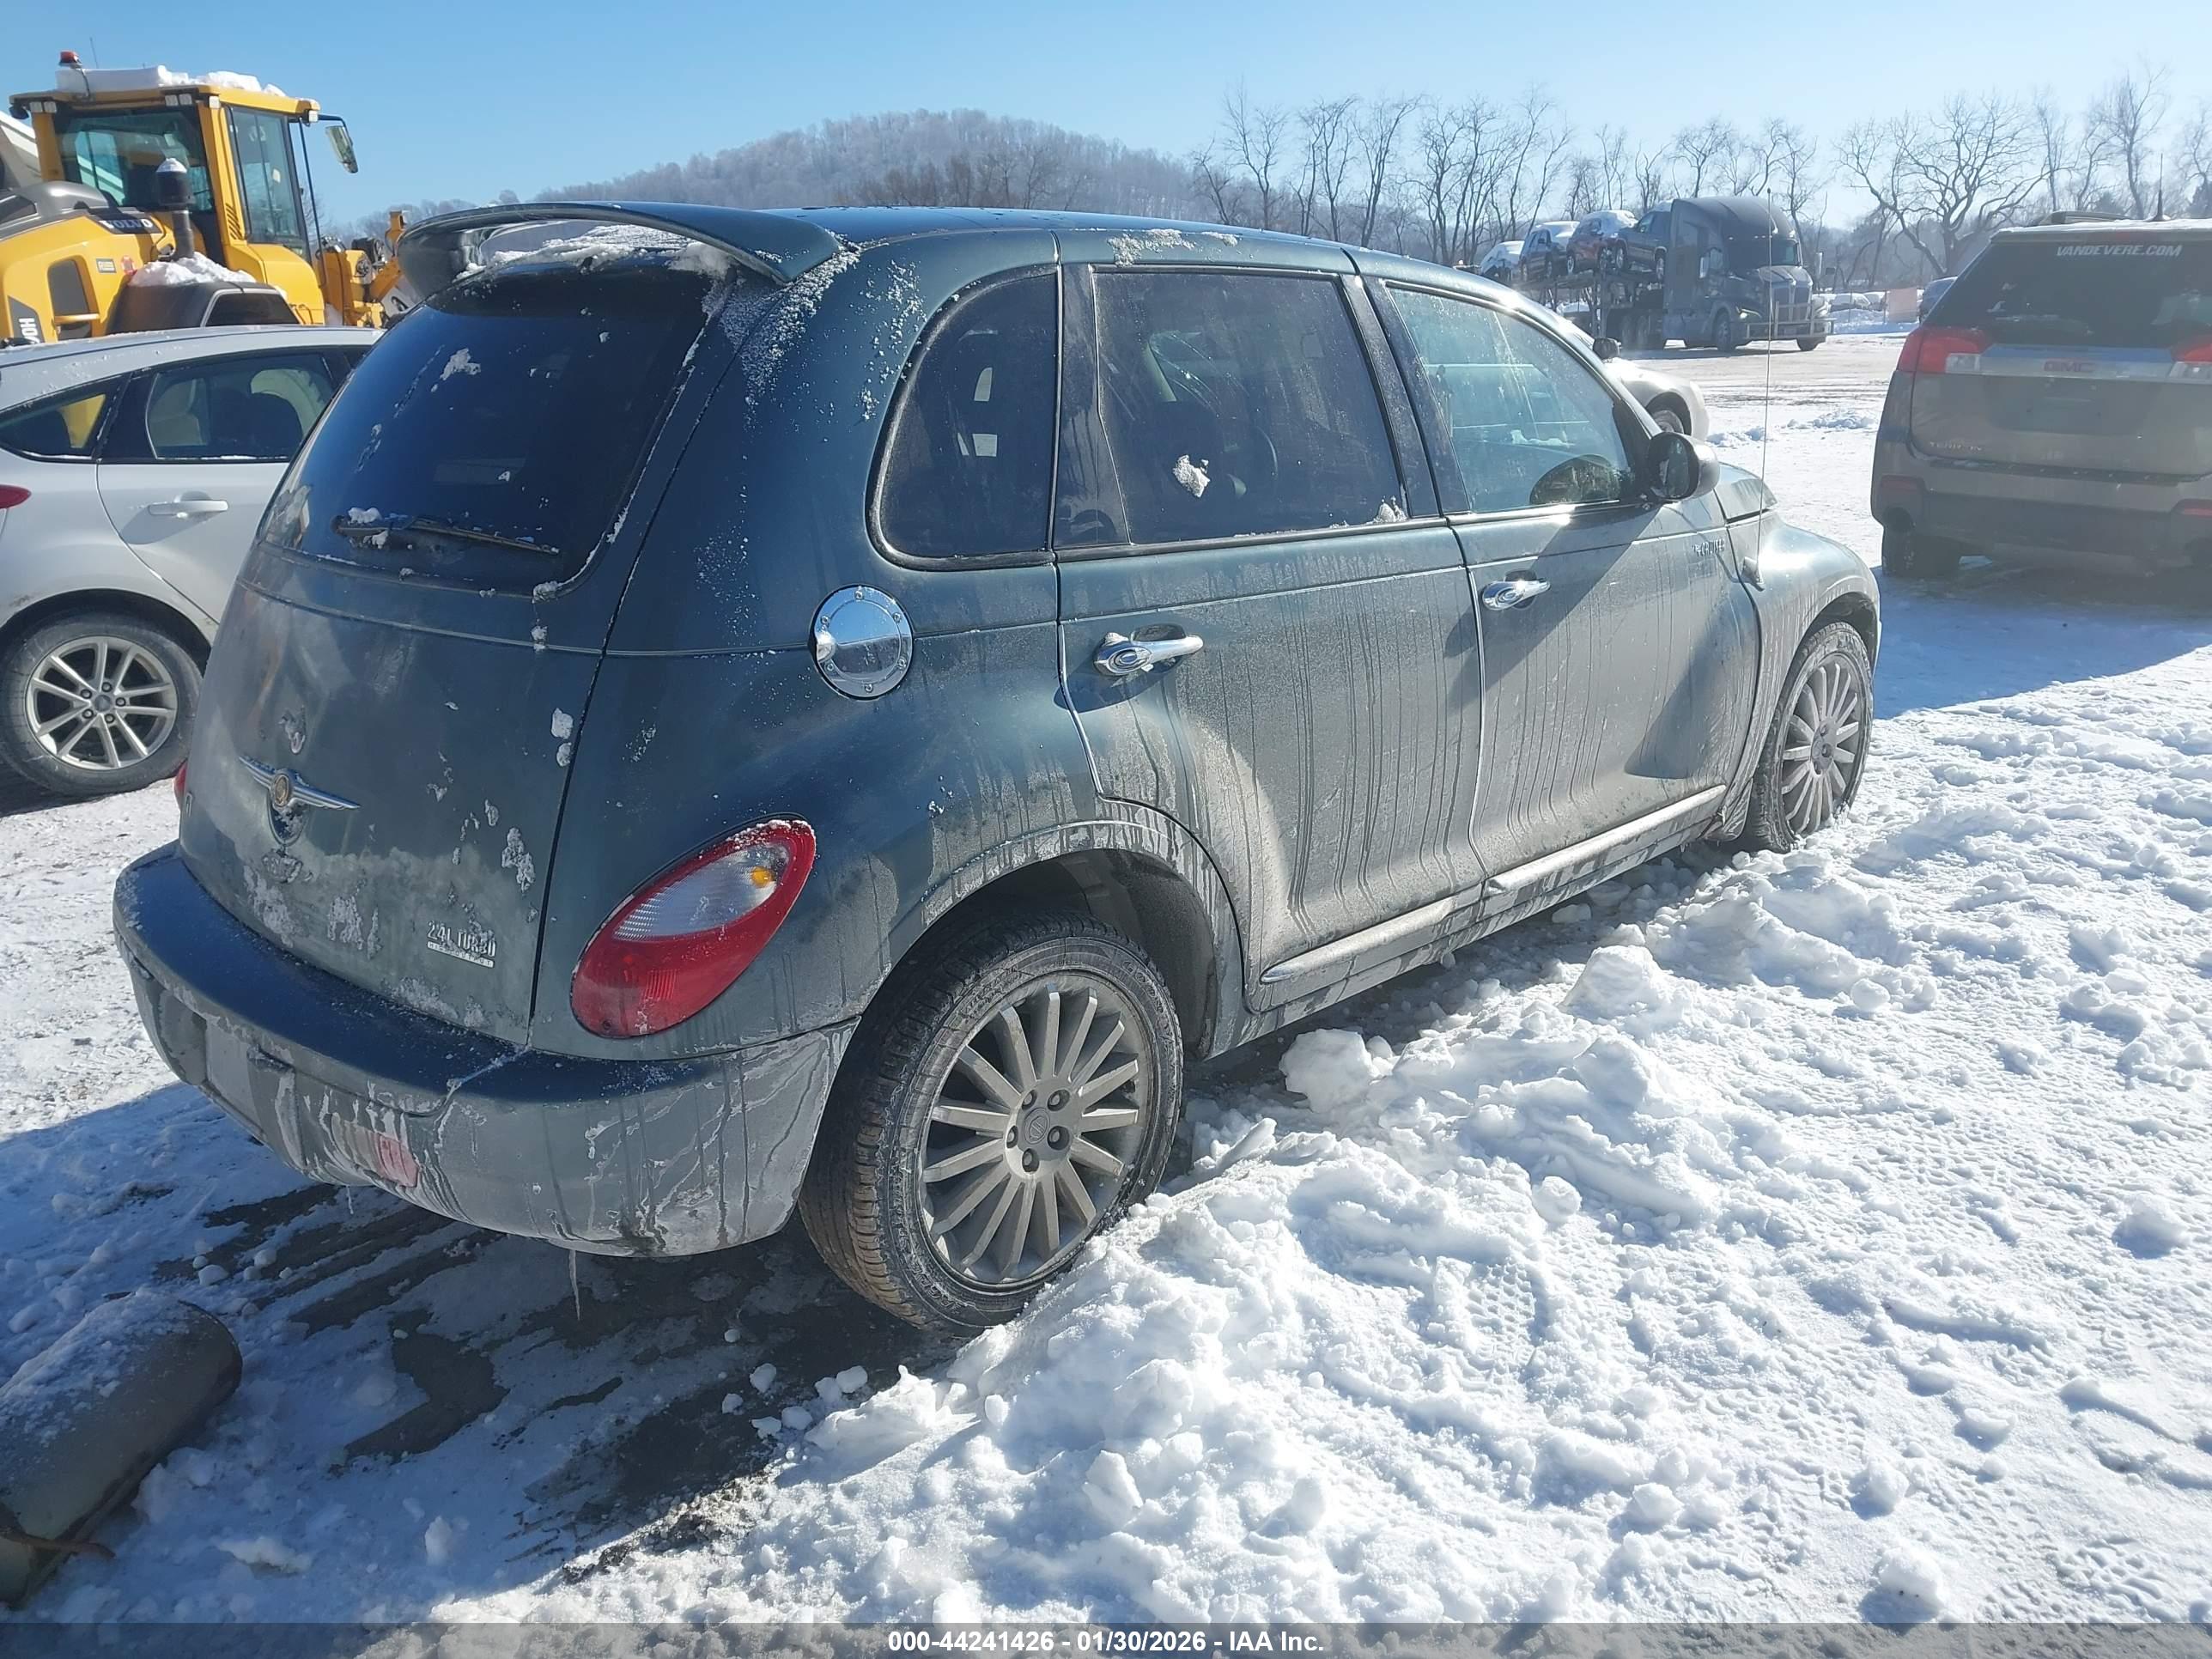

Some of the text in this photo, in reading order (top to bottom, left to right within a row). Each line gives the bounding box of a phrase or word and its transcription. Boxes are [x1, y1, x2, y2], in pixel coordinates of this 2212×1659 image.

[99, 219, 153, 228] VOLVO
[2056, 245, 2182, 257] VANDEVERE.COM
[2043, 358, 2095, 373] GMC
